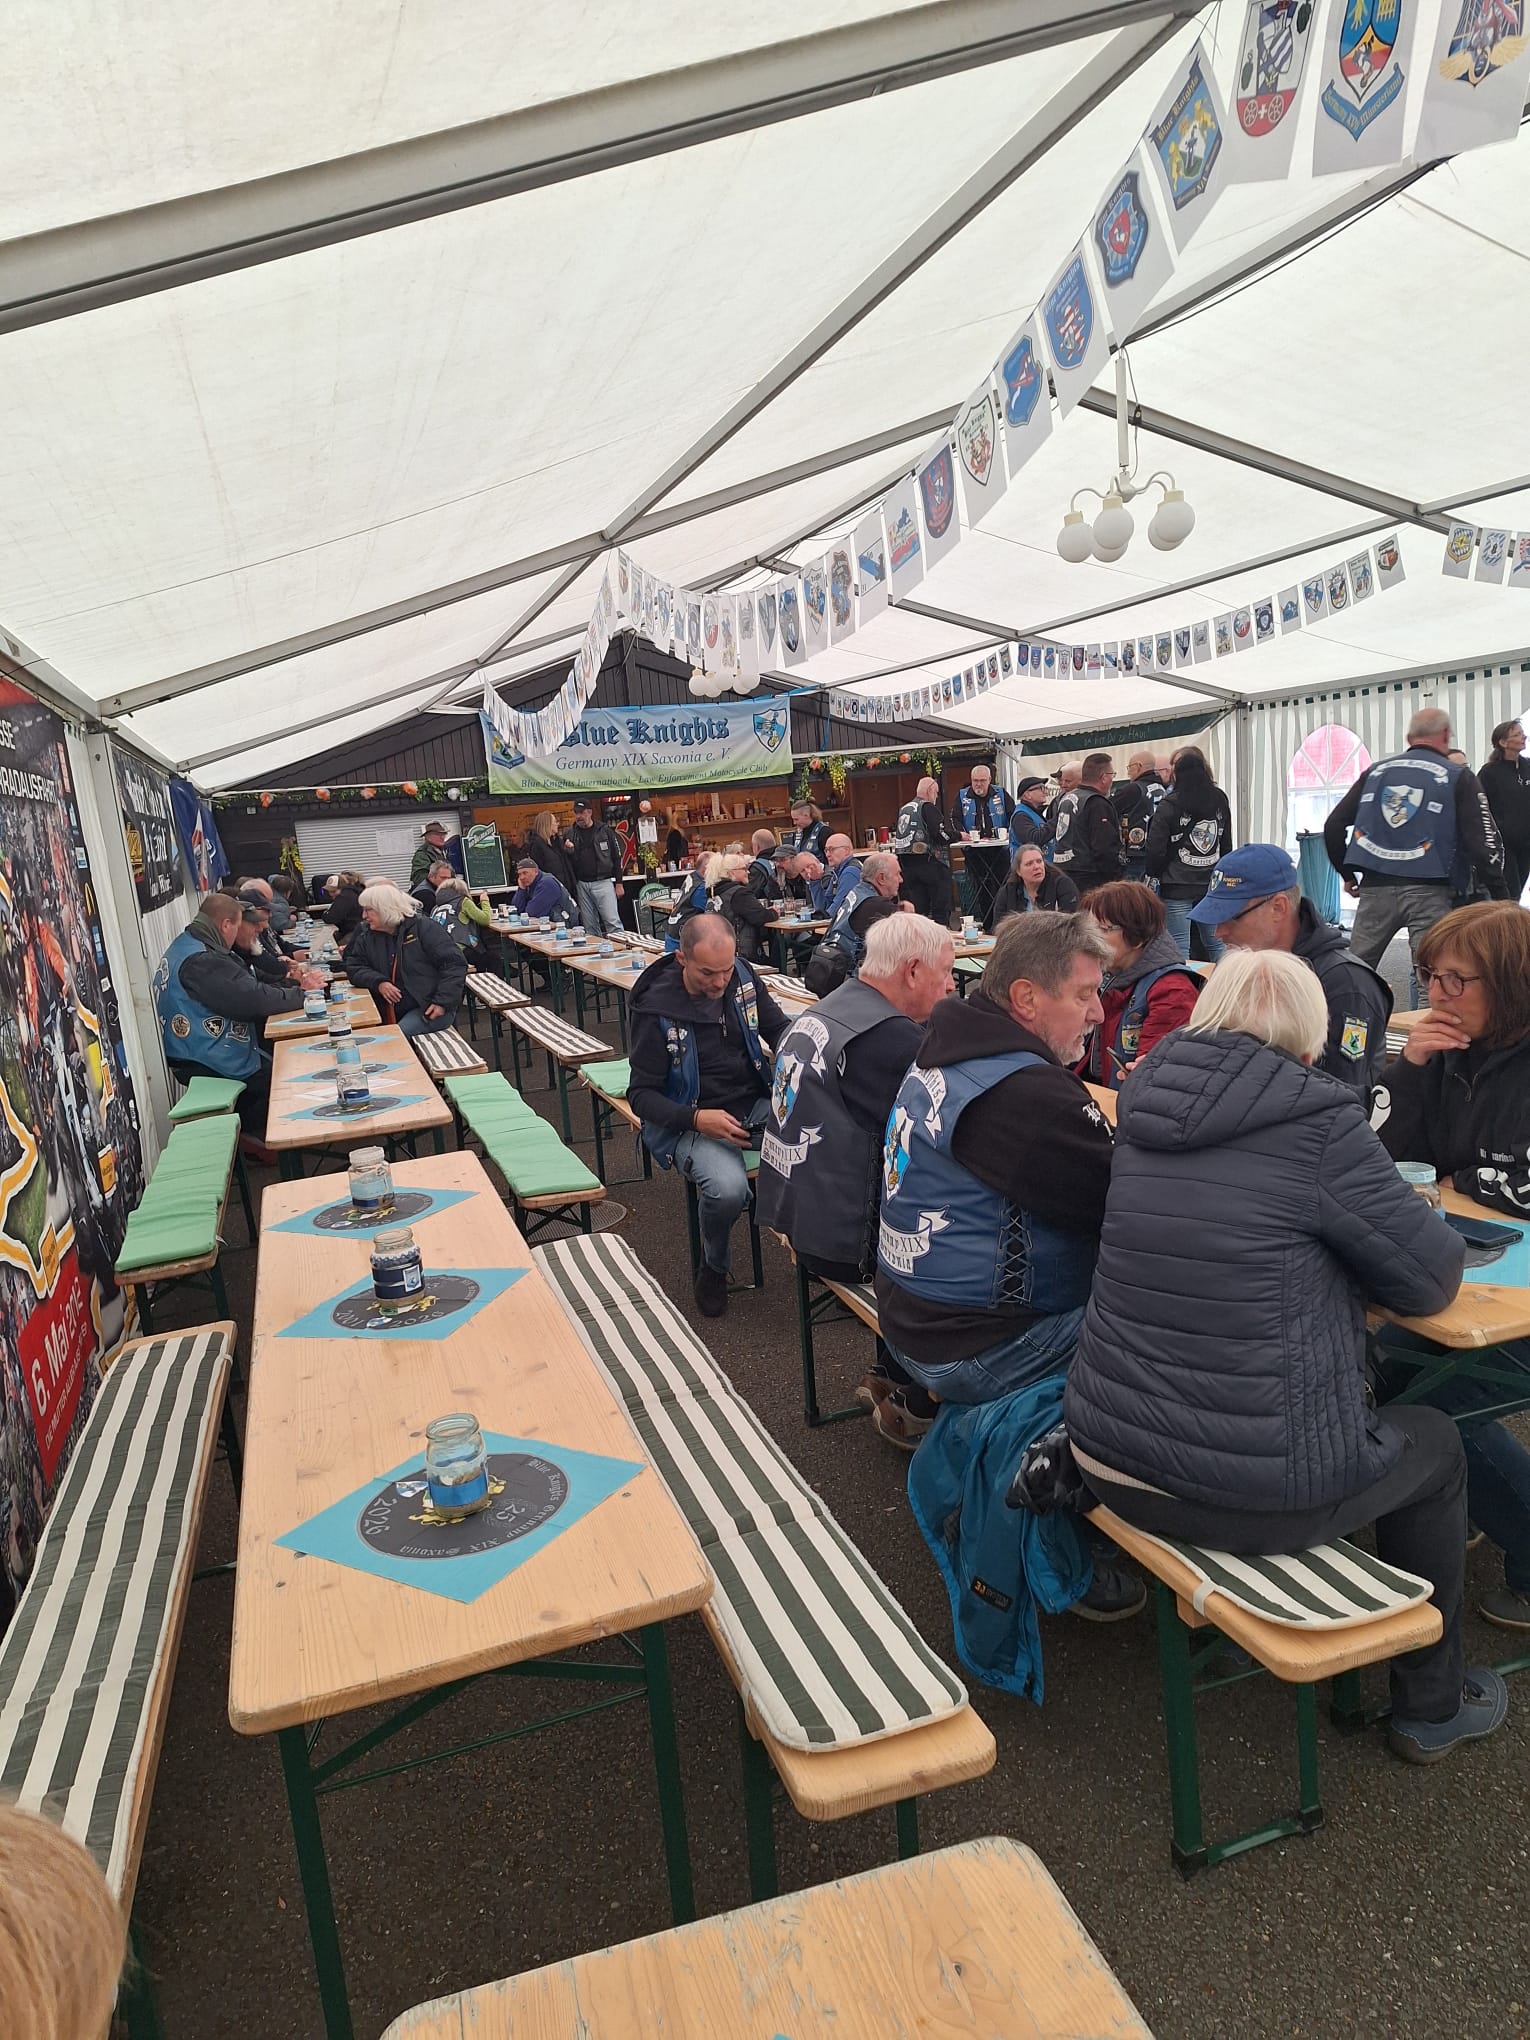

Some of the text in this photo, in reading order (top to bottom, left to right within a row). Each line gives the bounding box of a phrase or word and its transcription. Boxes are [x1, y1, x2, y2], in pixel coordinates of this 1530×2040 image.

[625, 715, 731, 747] Knights
[556, 756, 618, 771] Germany
[622, 753, 648, 767] XIX
[651, 752, 702, 765] Saxonia
[521, 778, 541, 788] Blue
[543, 777, 575, 789] Knights
[577, 775, 631, 788] International
[899, 1235, 925, 1253] XIX
[31, 1357, 51, 1417] 6.
[44, 1304, 69, 1386] Mai
[363, 1496, 398, 1536] 2026
[399, 1457, 565, 1558] Blue Knights Germany XIX Saxonia
[495, 1502, 526, 1523] 25
